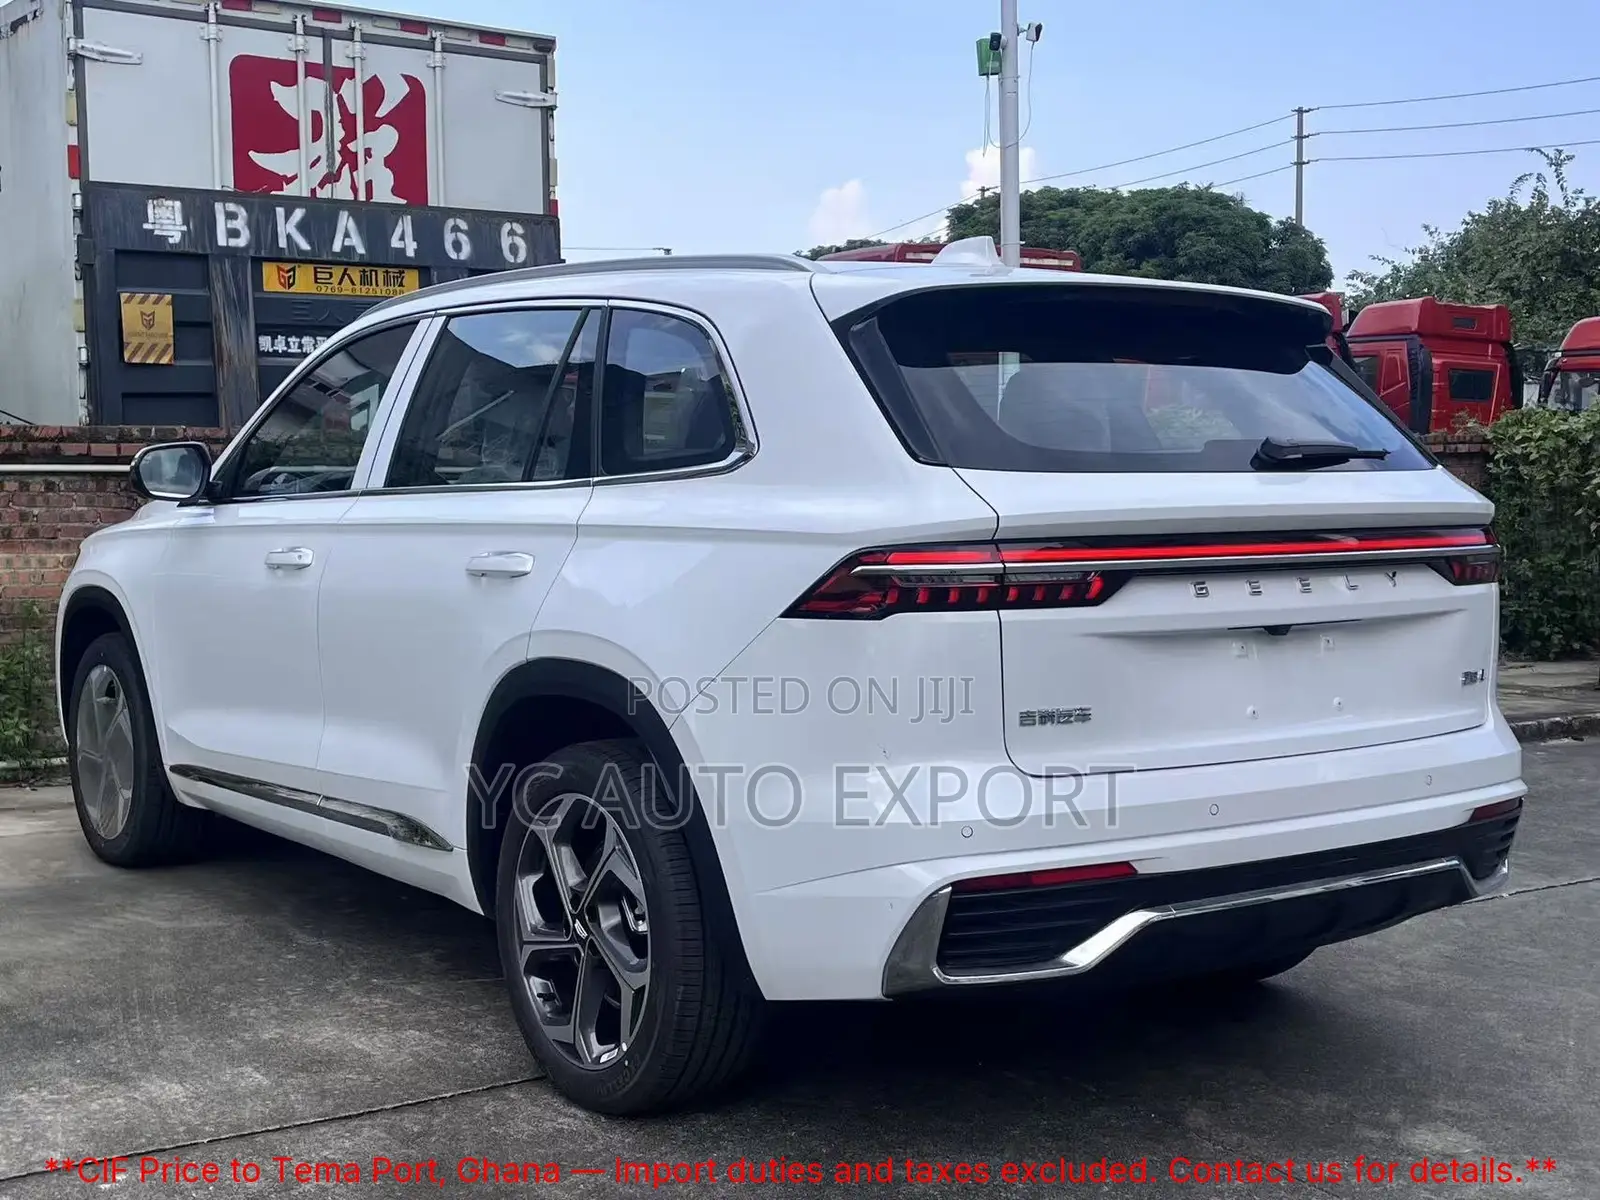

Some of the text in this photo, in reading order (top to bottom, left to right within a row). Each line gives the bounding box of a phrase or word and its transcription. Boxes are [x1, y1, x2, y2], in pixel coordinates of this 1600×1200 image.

[313, 266, 405, 287] 巨人机械
[1190, 571, 1397, 598] GEELY
